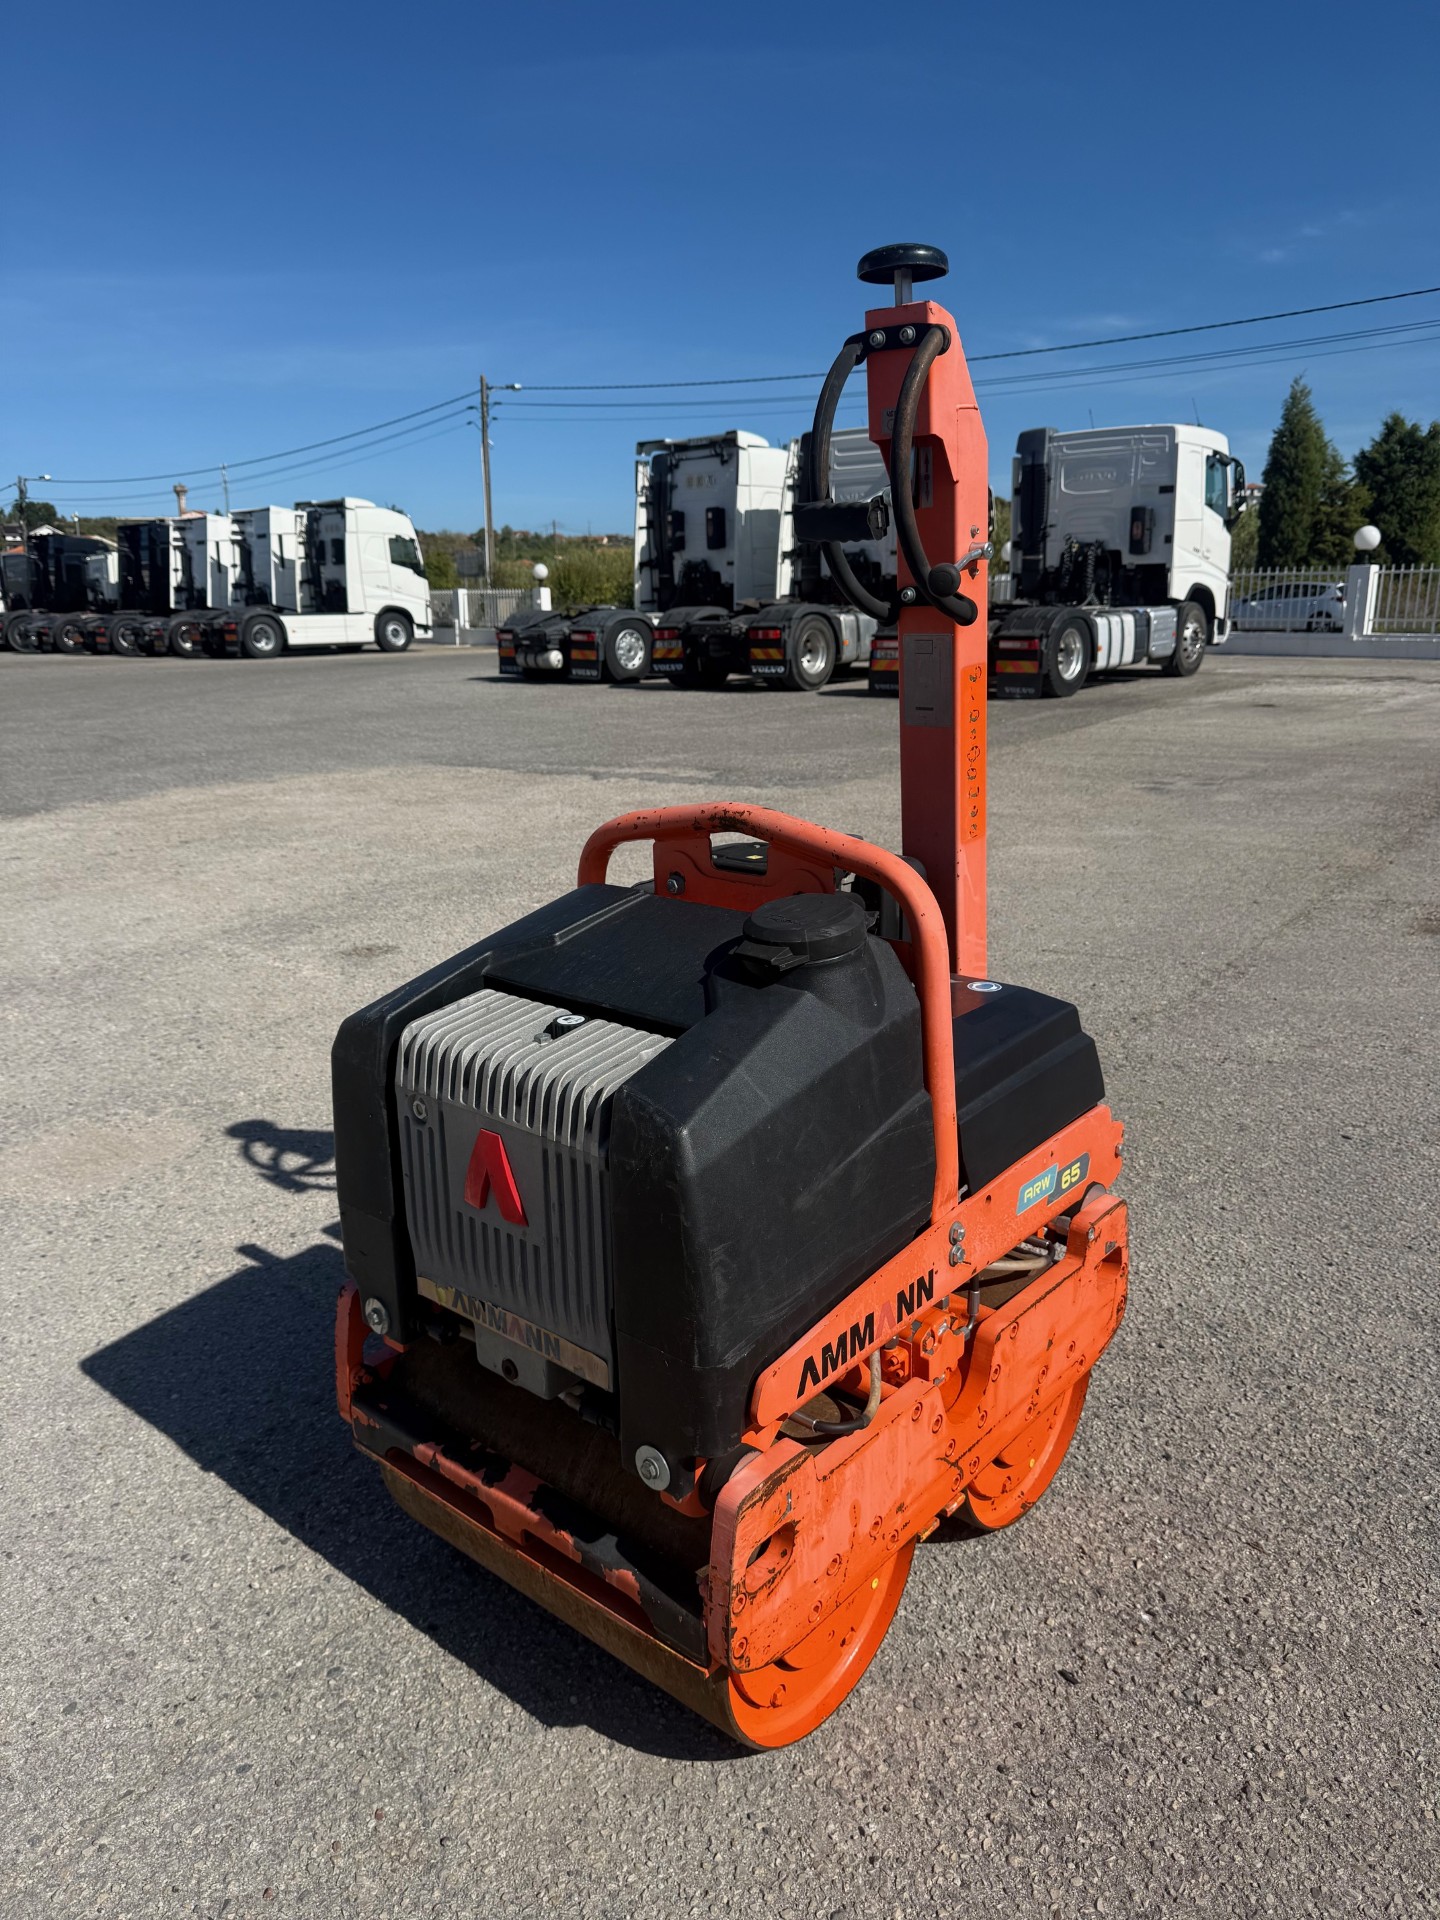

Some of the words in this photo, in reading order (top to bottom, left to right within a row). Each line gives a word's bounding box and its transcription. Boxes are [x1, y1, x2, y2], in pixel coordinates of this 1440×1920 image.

[653, 663, 683, 672] VOLVO
[751, 665, 785, 673] VOLVO
[1024, 1174, 1051, 1203] ARW
[1061, 1161, 1081, 1190] 65
[451, 1288, 561, 1361] AMMANN
[797, 1268, 934, 1400] AMMANN
